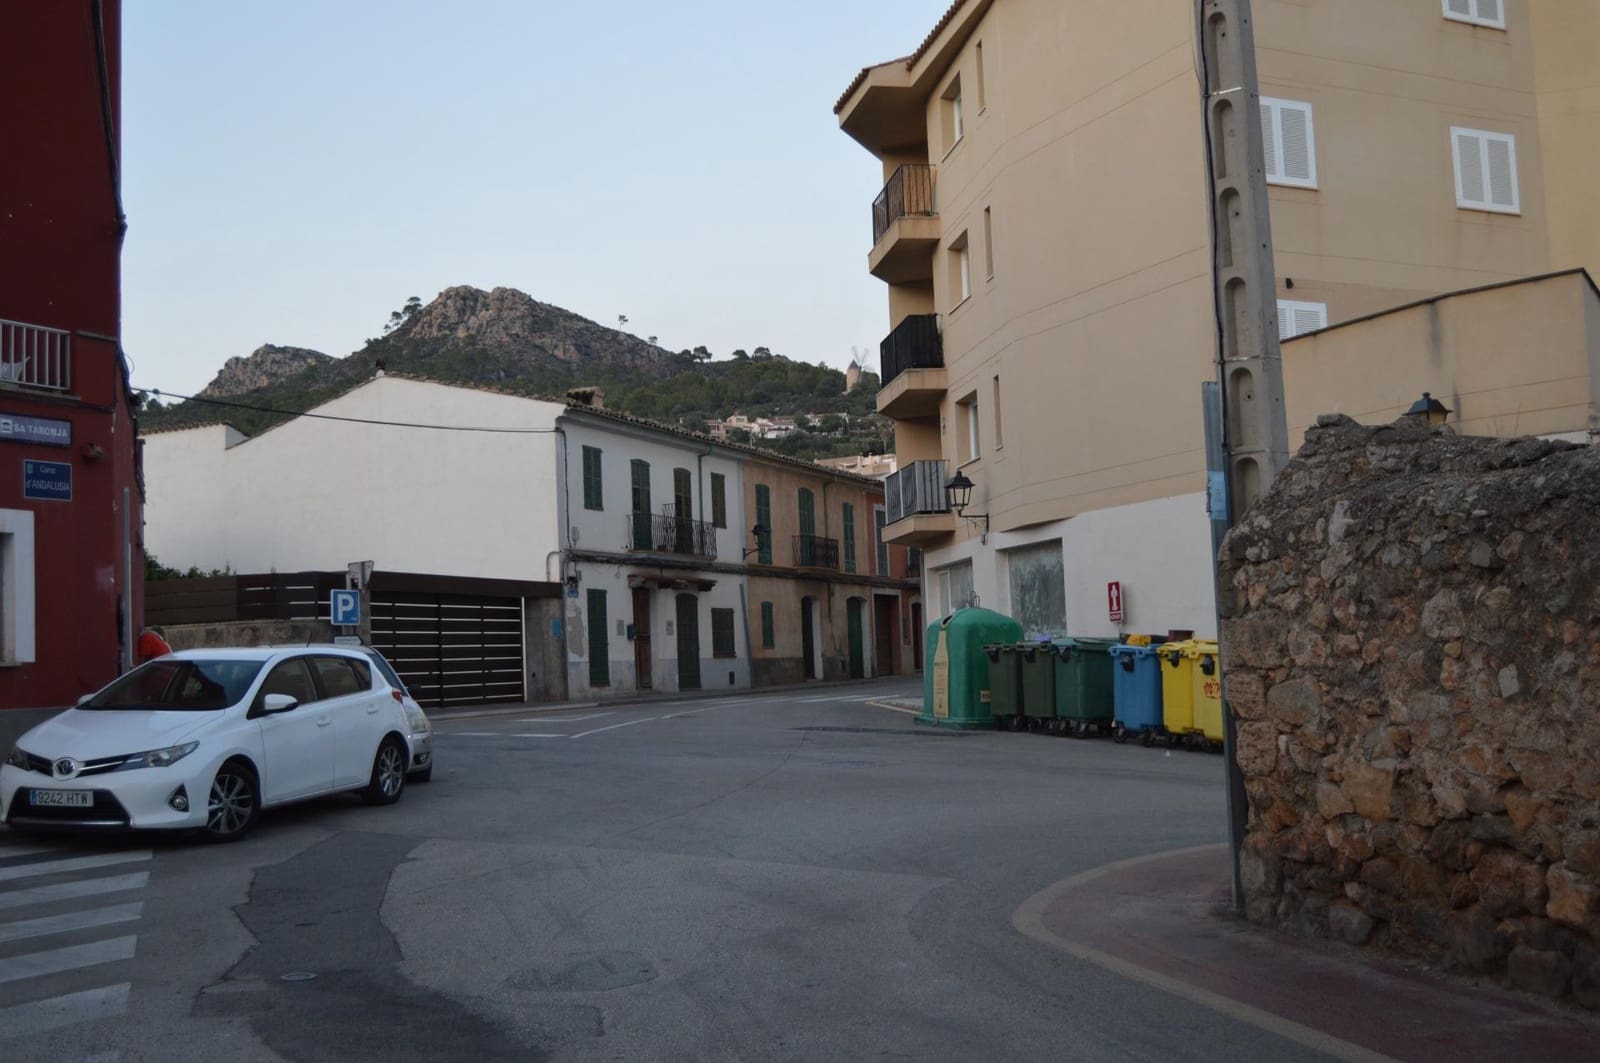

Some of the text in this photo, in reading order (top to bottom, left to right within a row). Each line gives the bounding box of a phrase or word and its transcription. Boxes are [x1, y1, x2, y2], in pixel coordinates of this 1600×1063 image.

[14, 423, 69, 437] SA TARONJA
[337, 593, 355, 621] P
